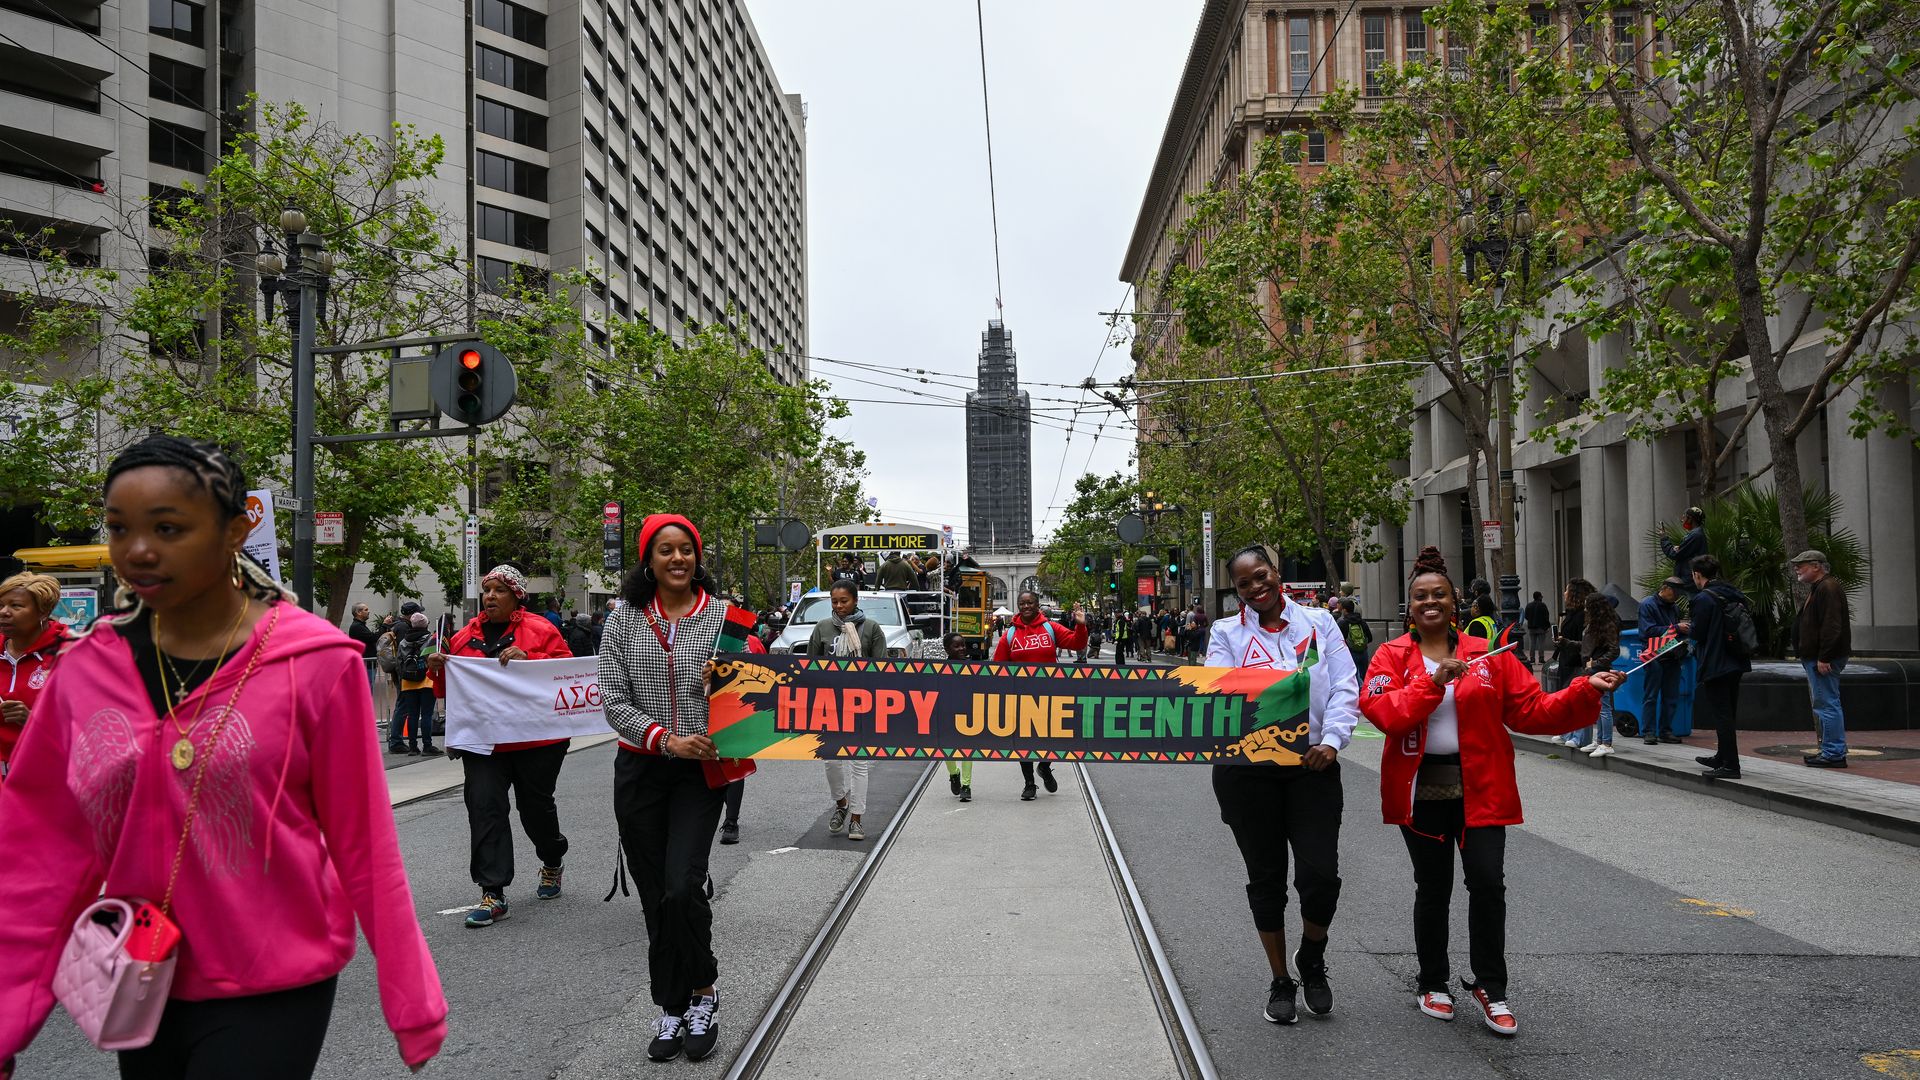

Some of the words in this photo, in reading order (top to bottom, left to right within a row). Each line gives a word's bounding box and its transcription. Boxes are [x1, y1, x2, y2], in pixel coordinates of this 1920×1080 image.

[278, 498, 298, 509] MARKET
[830, 535, 849, 550] 22
[853, 535, 927, 549] FILLMORE
[777, 686, 939, 735] HAPPY
[955, 693, 1243, 738] JUNETEENTH
